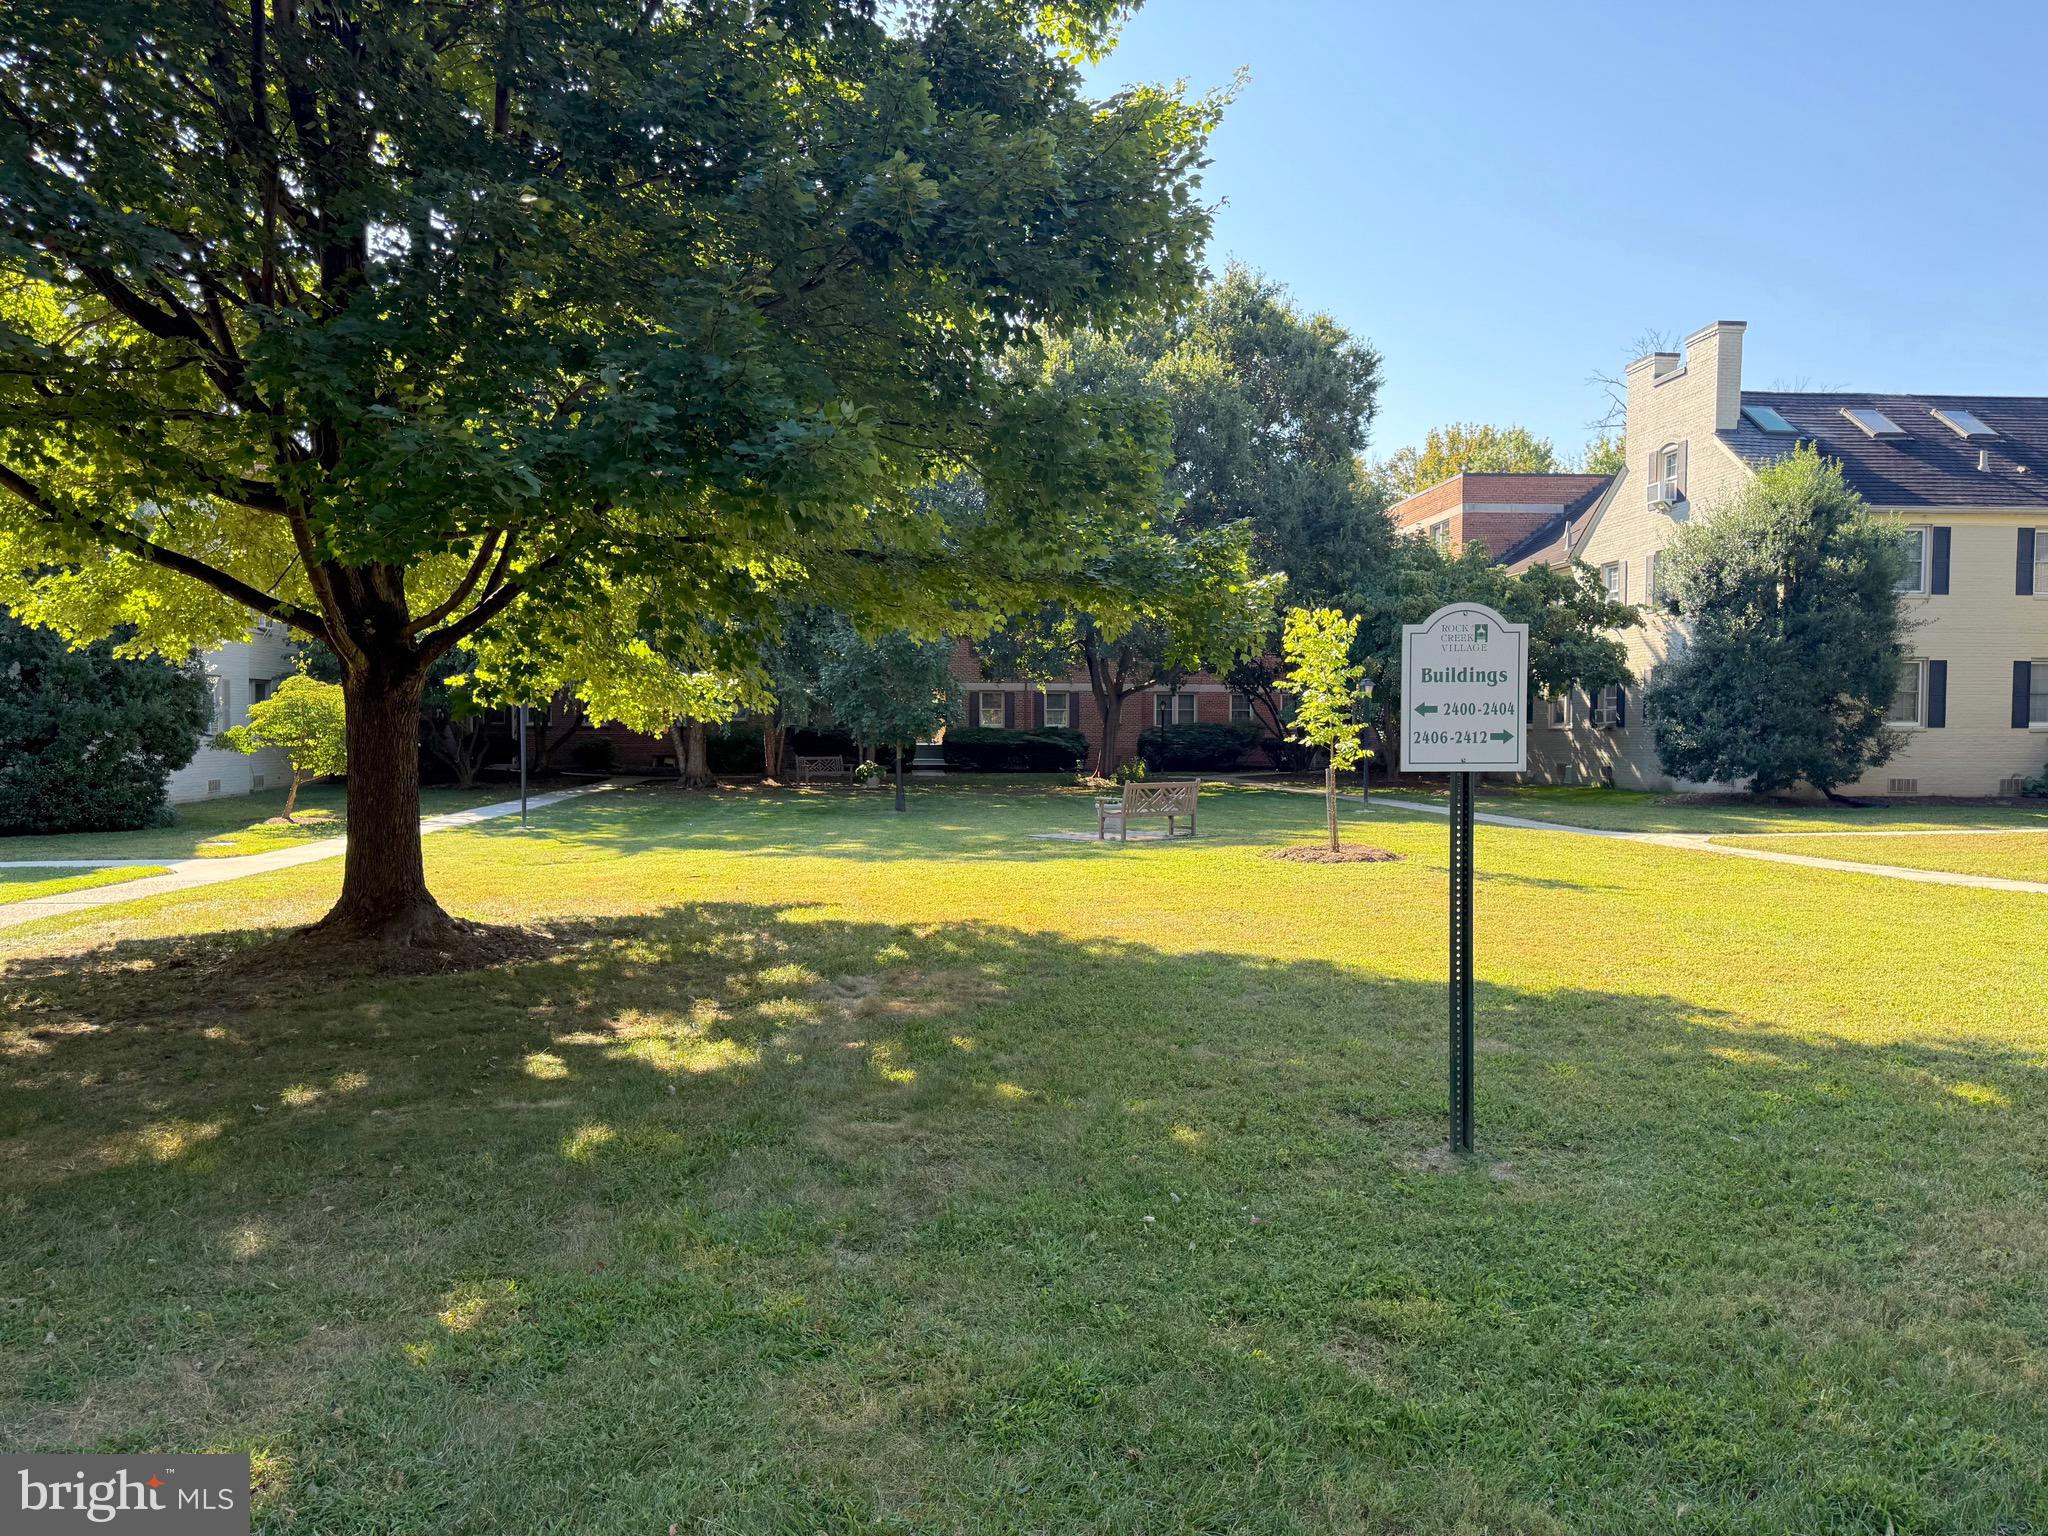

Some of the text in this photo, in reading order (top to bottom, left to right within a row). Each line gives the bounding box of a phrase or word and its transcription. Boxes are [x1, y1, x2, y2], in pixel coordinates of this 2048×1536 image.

[1441, 624, 1468, 632] ROCK
[1440, 634, 1475, 642] CREEK
[1441, 644, 1487, 652] VILLAGE
[1421, 667, 1508, 687] Buildings
[1443, 702, 1515, 716] 2400-2404
[1413, 730, 1487, 744] 2406-2412
